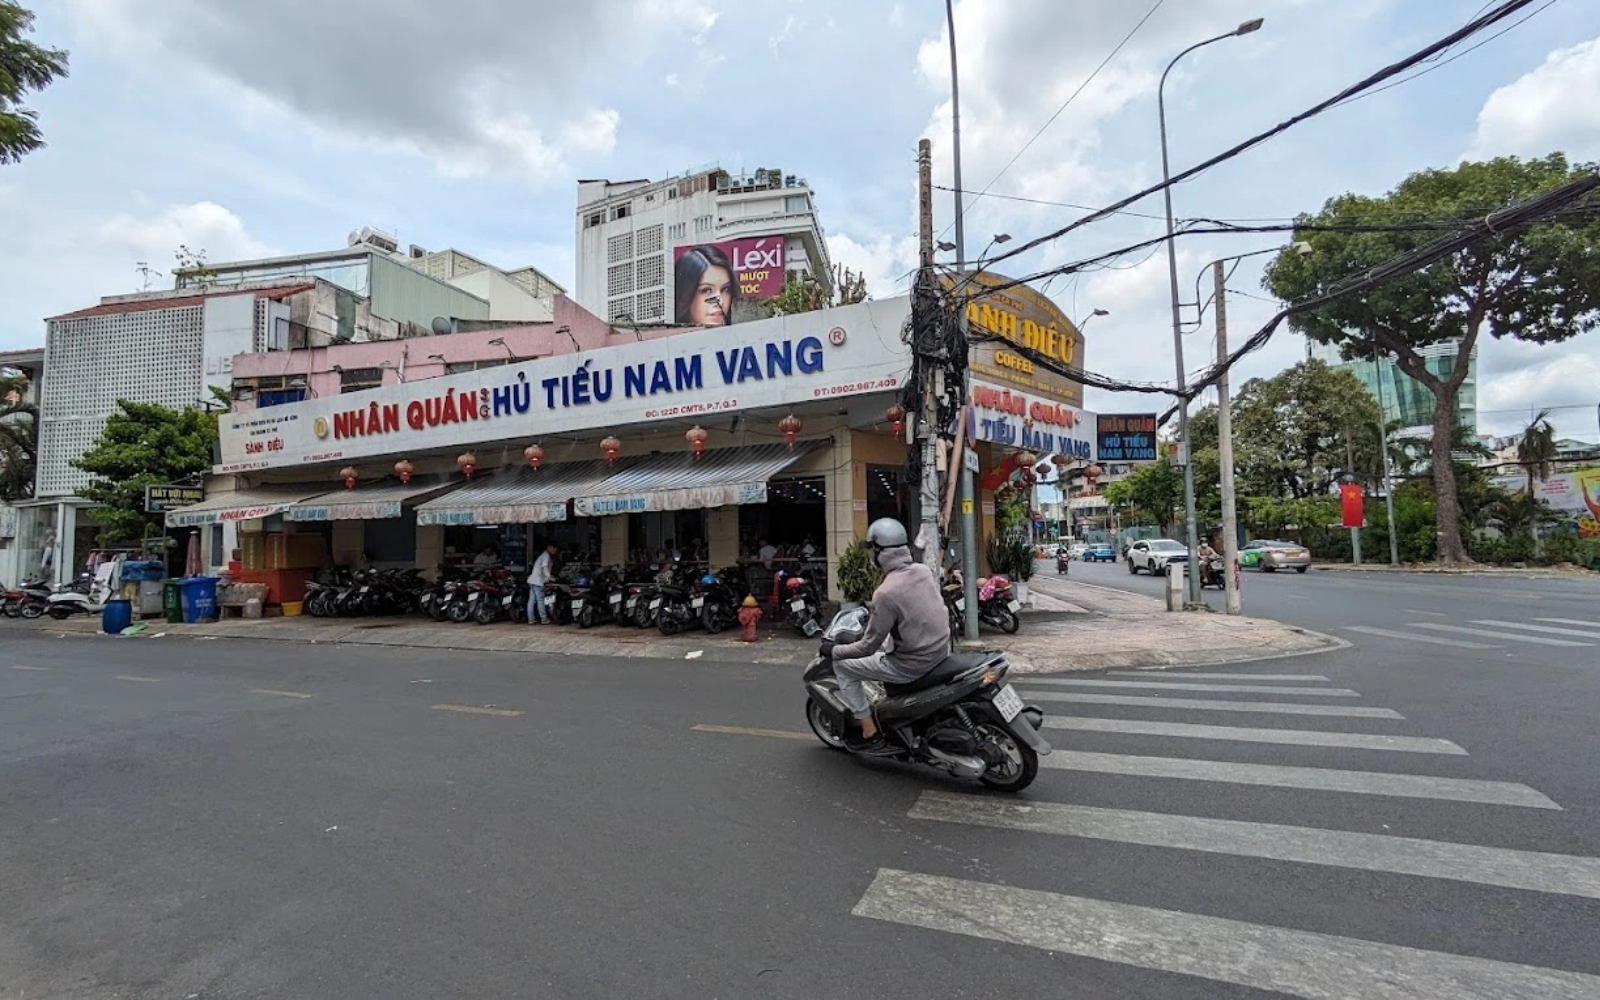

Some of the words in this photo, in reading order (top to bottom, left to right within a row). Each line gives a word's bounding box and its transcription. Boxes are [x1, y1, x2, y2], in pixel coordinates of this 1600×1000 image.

[733, 239, 781, 271] Léxi
[740, 284, 760, 294] TÓC
[493, 371, 531, 417] HỦ
[542, 359, 613, 409] TIẾU
[625, 355, 704, 398] NAM
[716, 337, 824, 385] VANG
[994, 350, 1035, 375] COFFEE
[333, 401, 400, 439] NHÂN
[407, 387, 478, 430] QUÁN
[974, 386, 1026, 416] NHÂN
[1030, 403, 1074, 428] QUÁN
[980, 416, 1016, 443] TIẾU
[1022, 428, 1054, 452] NAM
[1058, 436, 1091, 459] VANG
[1099, 448, 1122, 459] NAM
[1125, 448, 1155, 459] VANG
[1123, 433, 1149, 447] TIẾU
